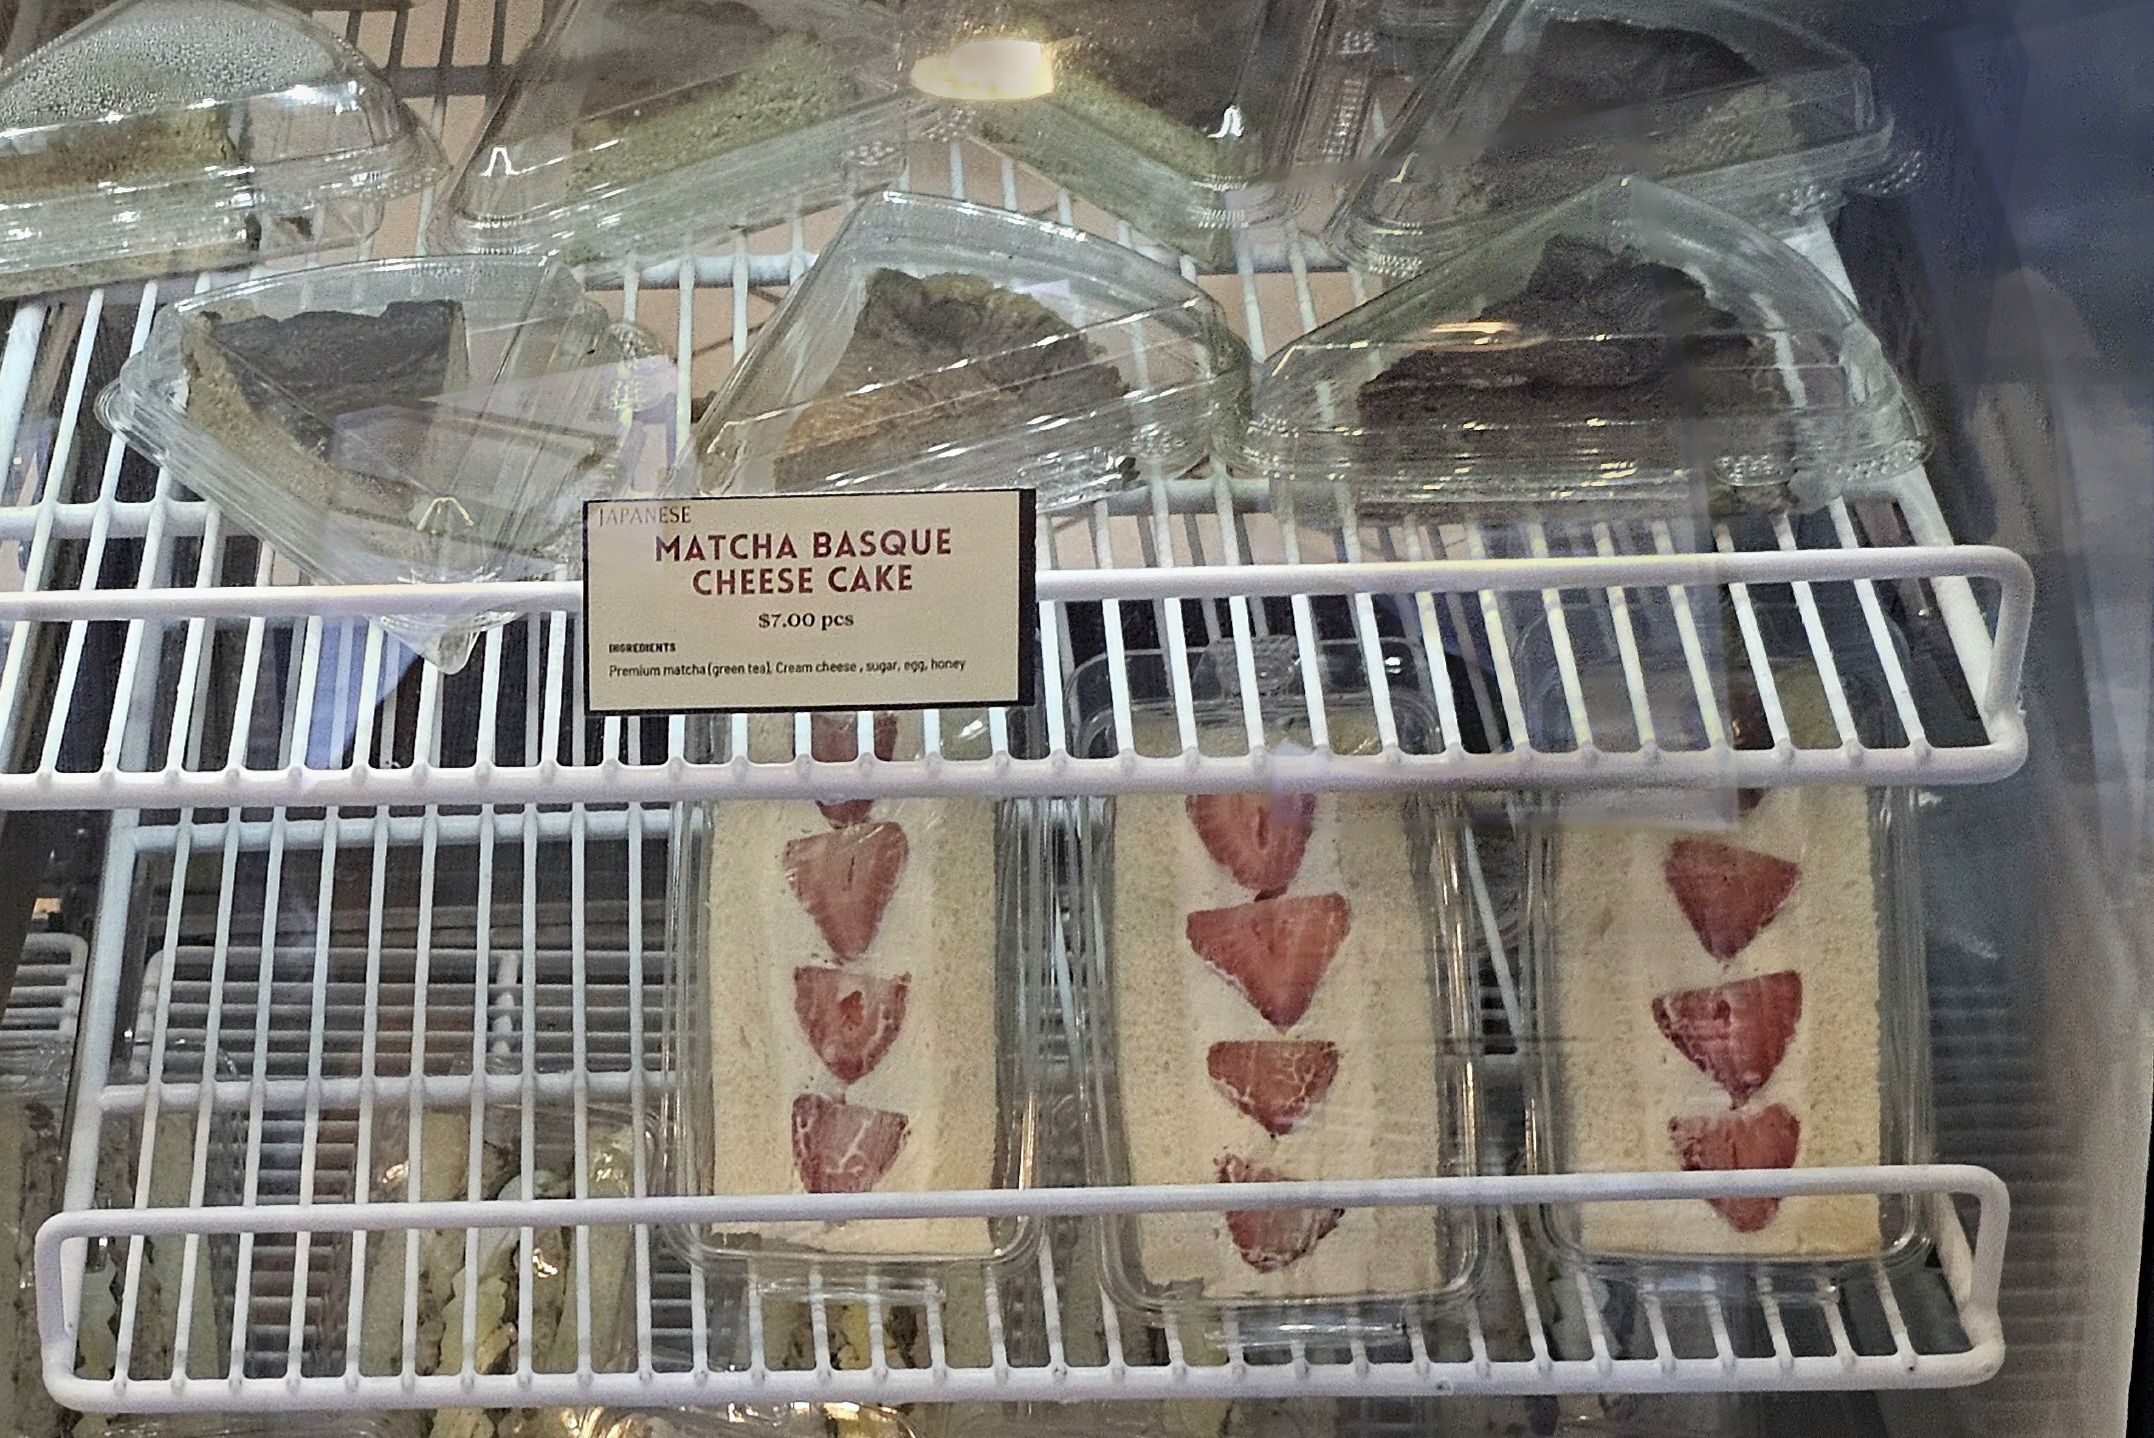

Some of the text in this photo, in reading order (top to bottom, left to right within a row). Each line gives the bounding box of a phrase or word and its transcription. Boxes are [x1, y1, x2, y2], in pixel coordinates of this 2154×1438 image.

[600, 506, 691, 526] JAPANESE
[655, 527, 951, 562] MATCHA BASQUE
[692, 564, 912, 595] CHEESE CAKE
[758, 612, 854, 631] $7.00 pcs
[608, 642, 676, 653] INGREDIENTS
[609, 664, 661, 677] Premium
[775, 661, 813, 674] Cream
[815, 660, 857, 673] cheese
[866, 660, 900, 674] sugar,
[904, 661, 928, 673] egg,
[931, 657, 966, 672] honey
